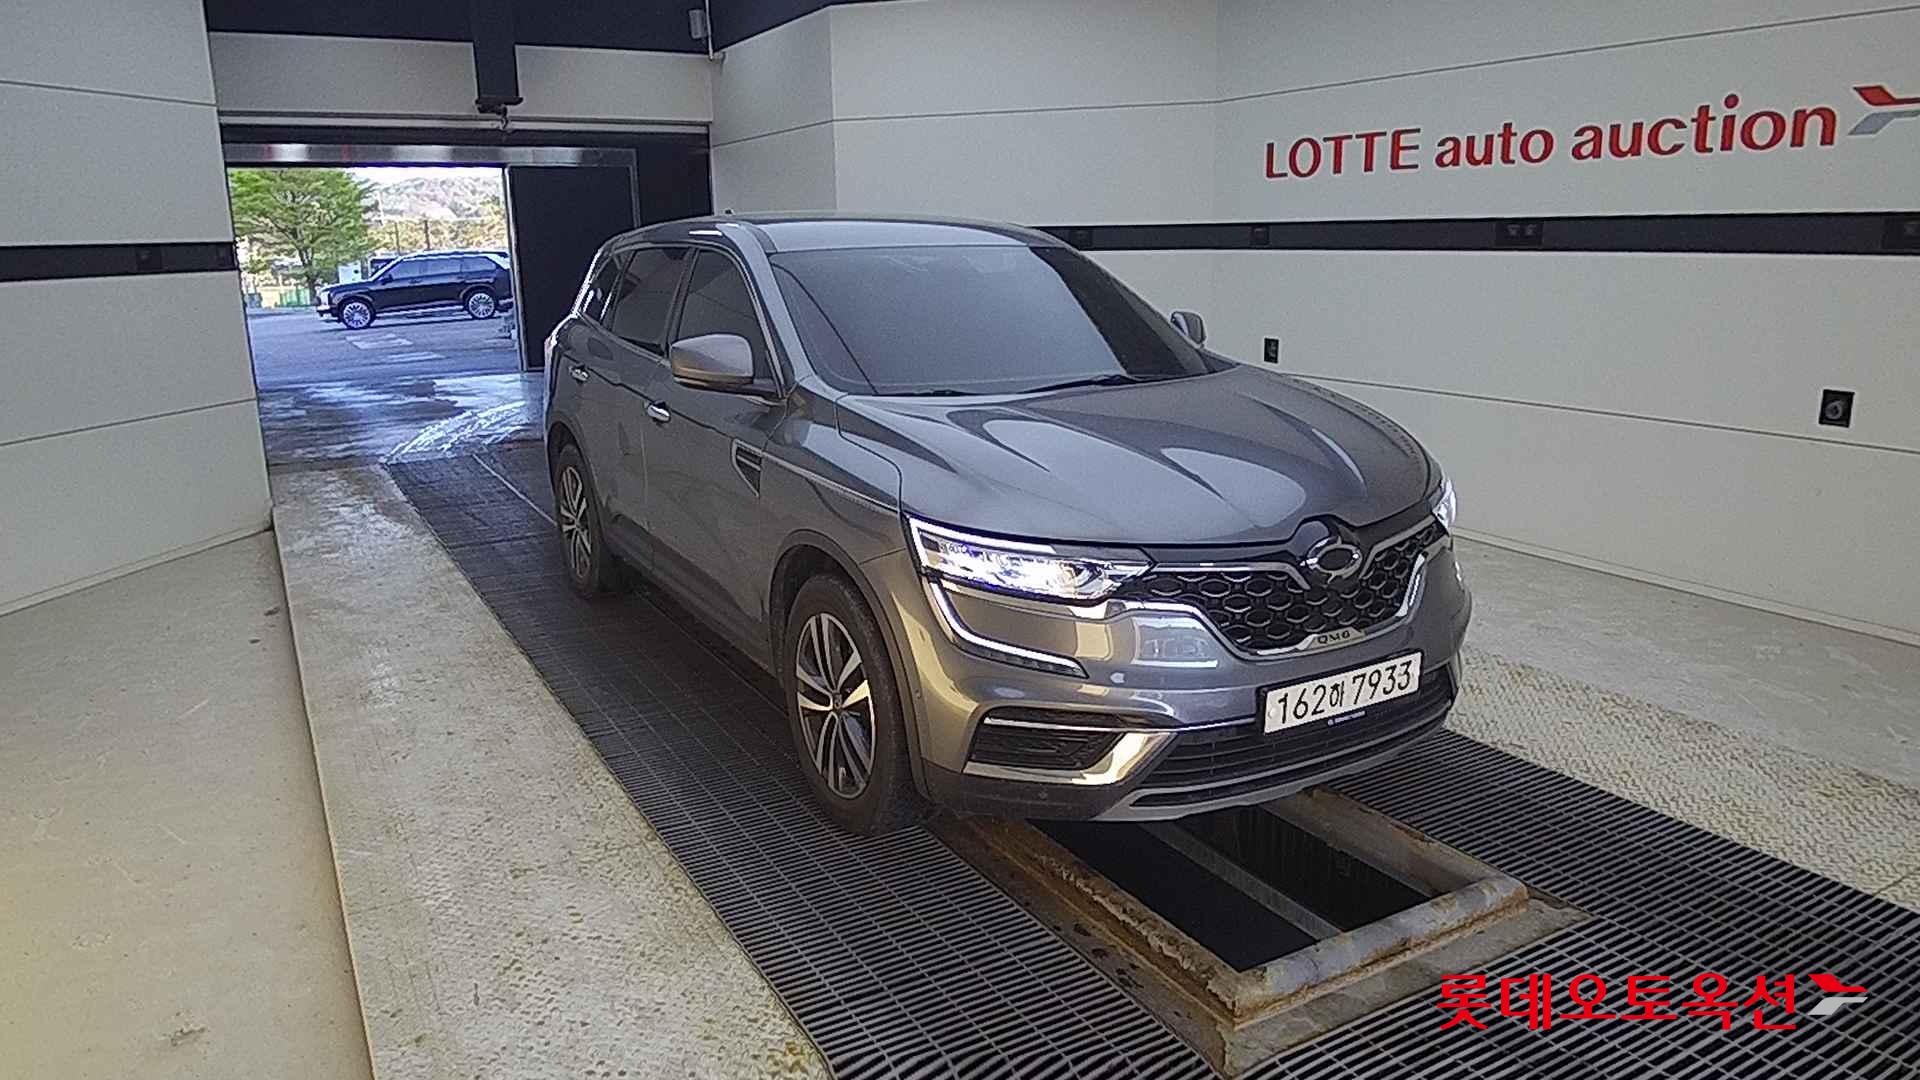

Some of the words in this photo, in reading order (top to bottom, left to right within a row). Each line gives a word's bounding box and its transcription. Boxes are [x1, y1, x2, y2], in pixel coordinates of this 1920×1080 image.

[1266, 129, 1421, 178] LOTTE
[1436, 122, 1553, 167] auto
[1573, 95, 1837, 159] auction
[1351, 661, 1412, 705] 7933
